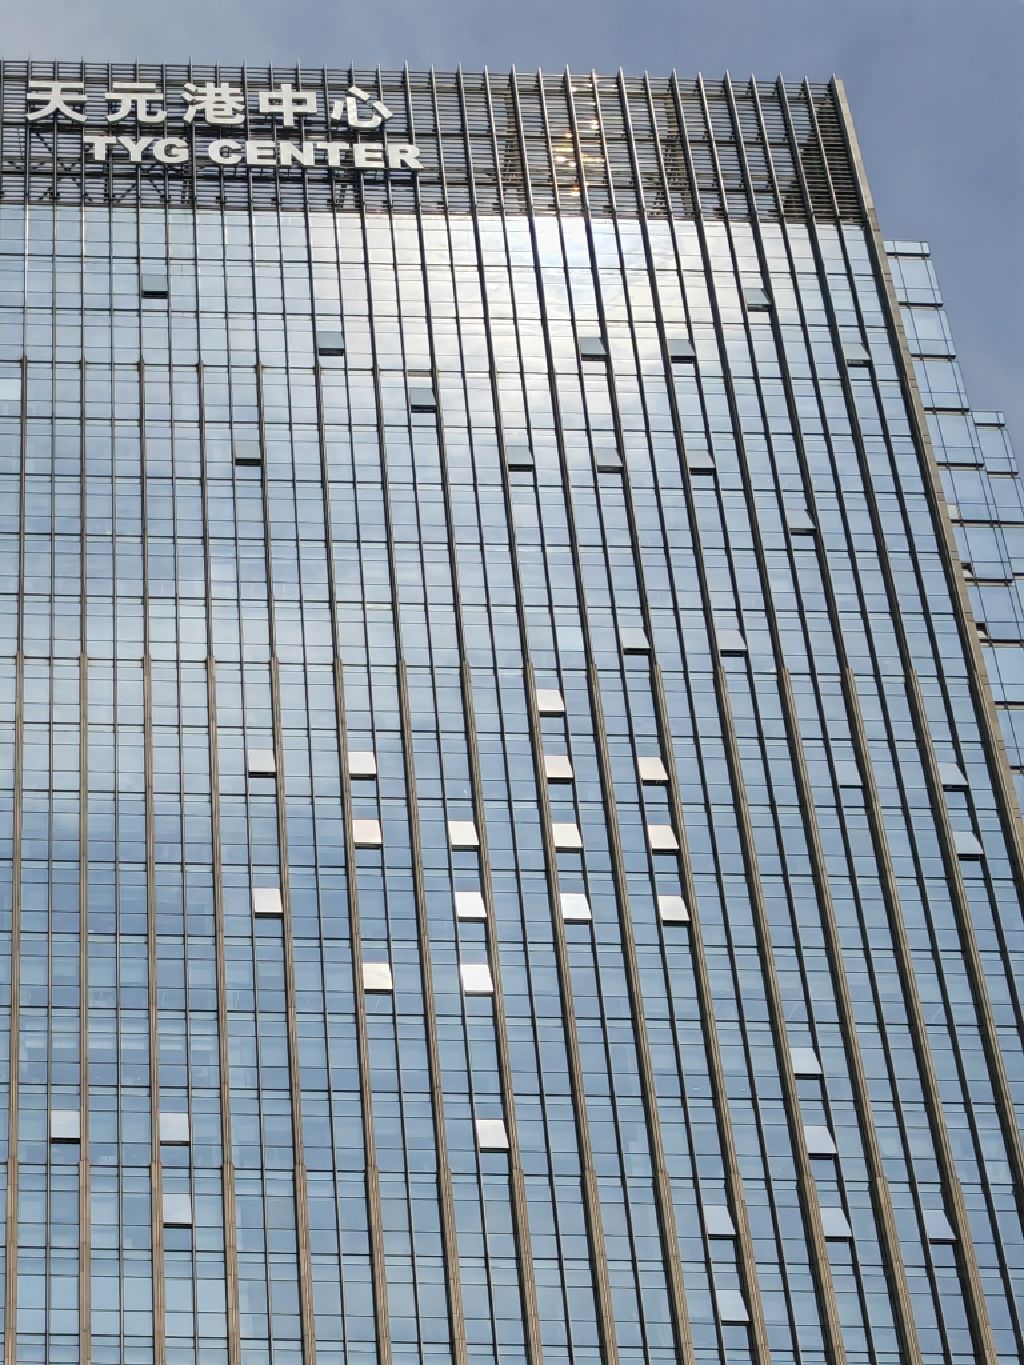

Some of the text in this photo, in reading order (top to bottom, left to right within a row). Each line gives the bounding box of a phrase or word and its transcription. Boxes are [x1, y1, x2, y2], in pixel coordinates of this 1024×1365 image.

[26, 80, 393, 129] 天元港中心
[83, 135, 424, 169] TYG CENTER
